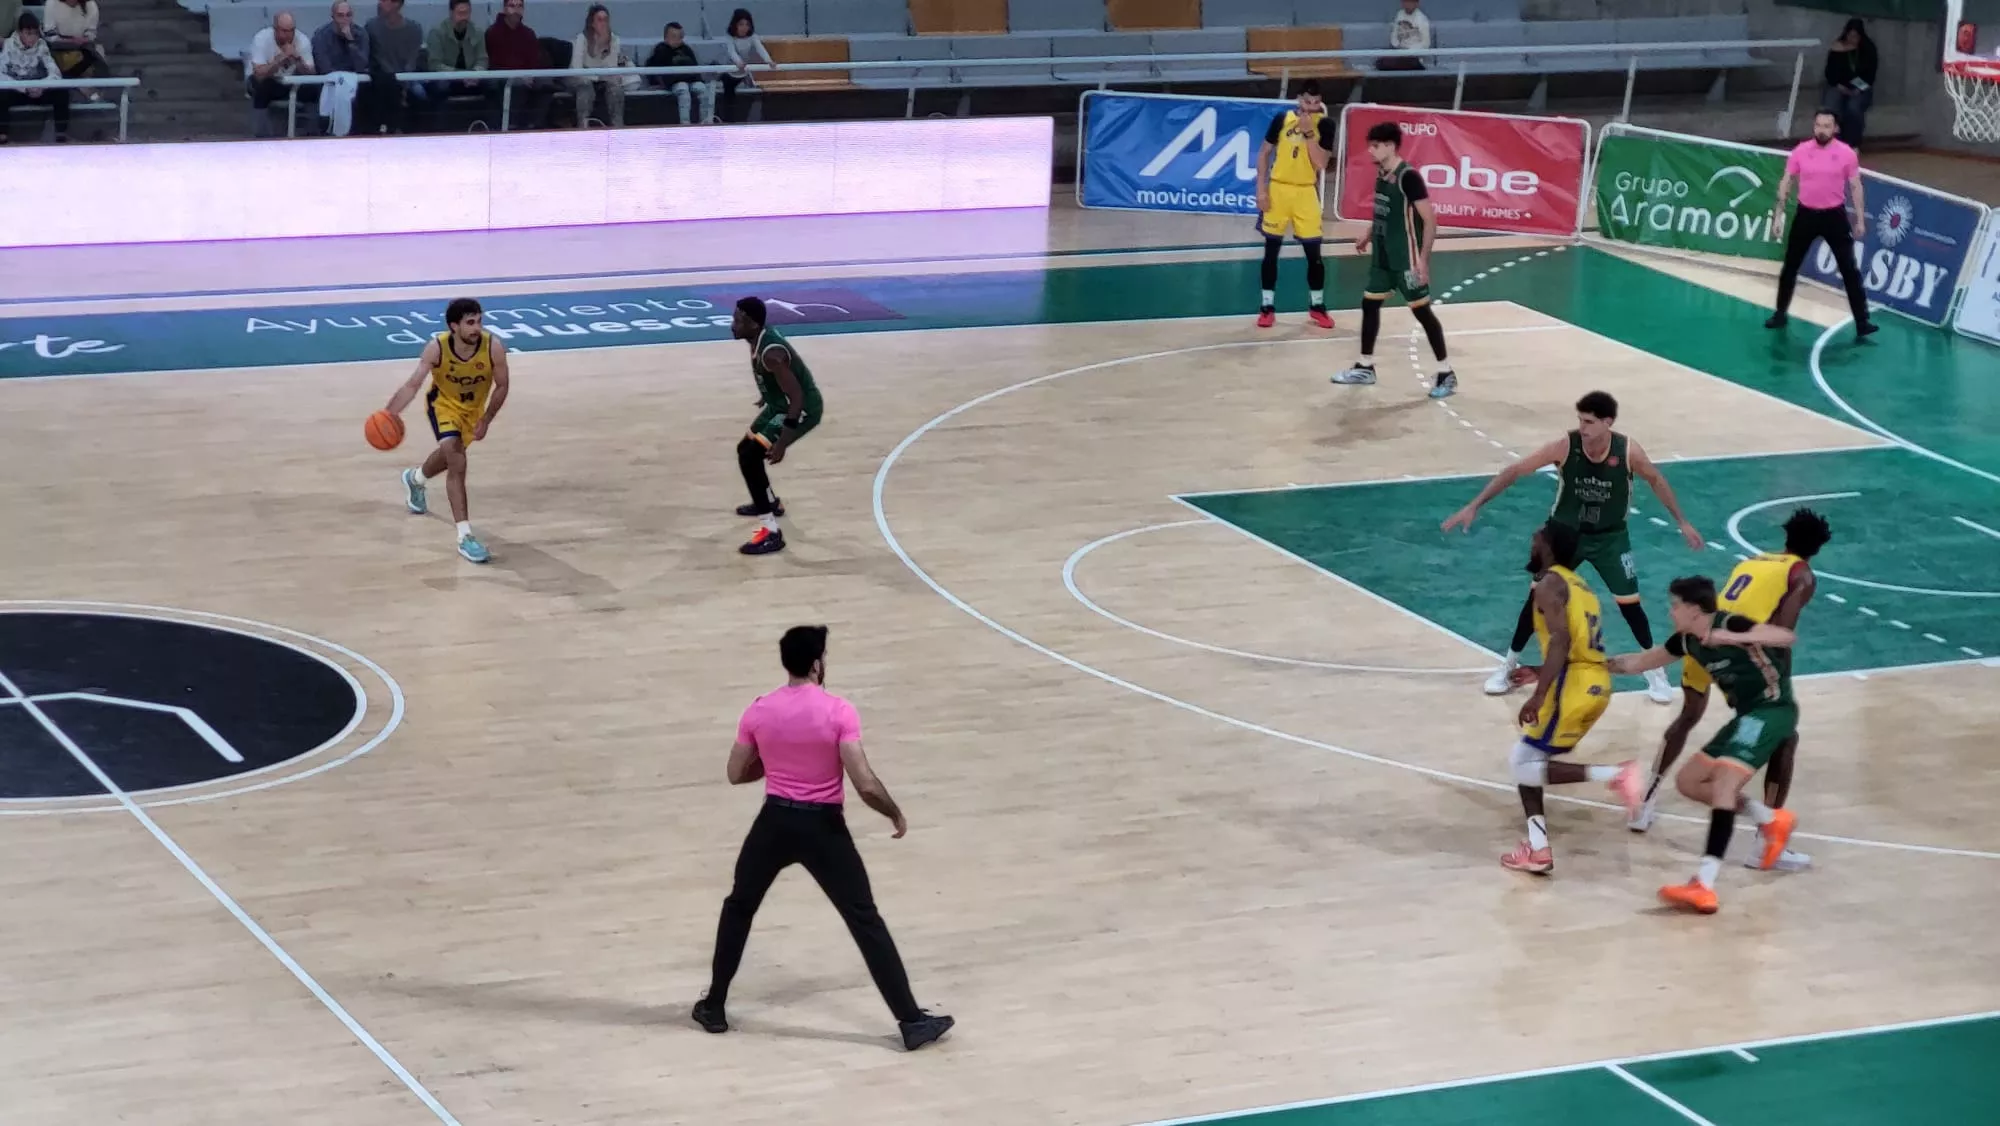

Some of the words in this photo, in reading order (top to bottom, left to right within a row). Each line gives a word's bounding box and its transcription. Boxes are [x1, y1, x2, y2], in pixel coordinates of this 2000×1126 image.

[1400, 122, 1438, 136] RUPO
[1419, 155, 1539, 195] obe
[1615, 171, 1689, 198] Grupo
[1136, 188, 1258, 208] movicoders
[1483, 207, 1520, 220] HOMES
[246, 298, 713, 335] Ayuntmiento
[0, 334, 127, 359] te
